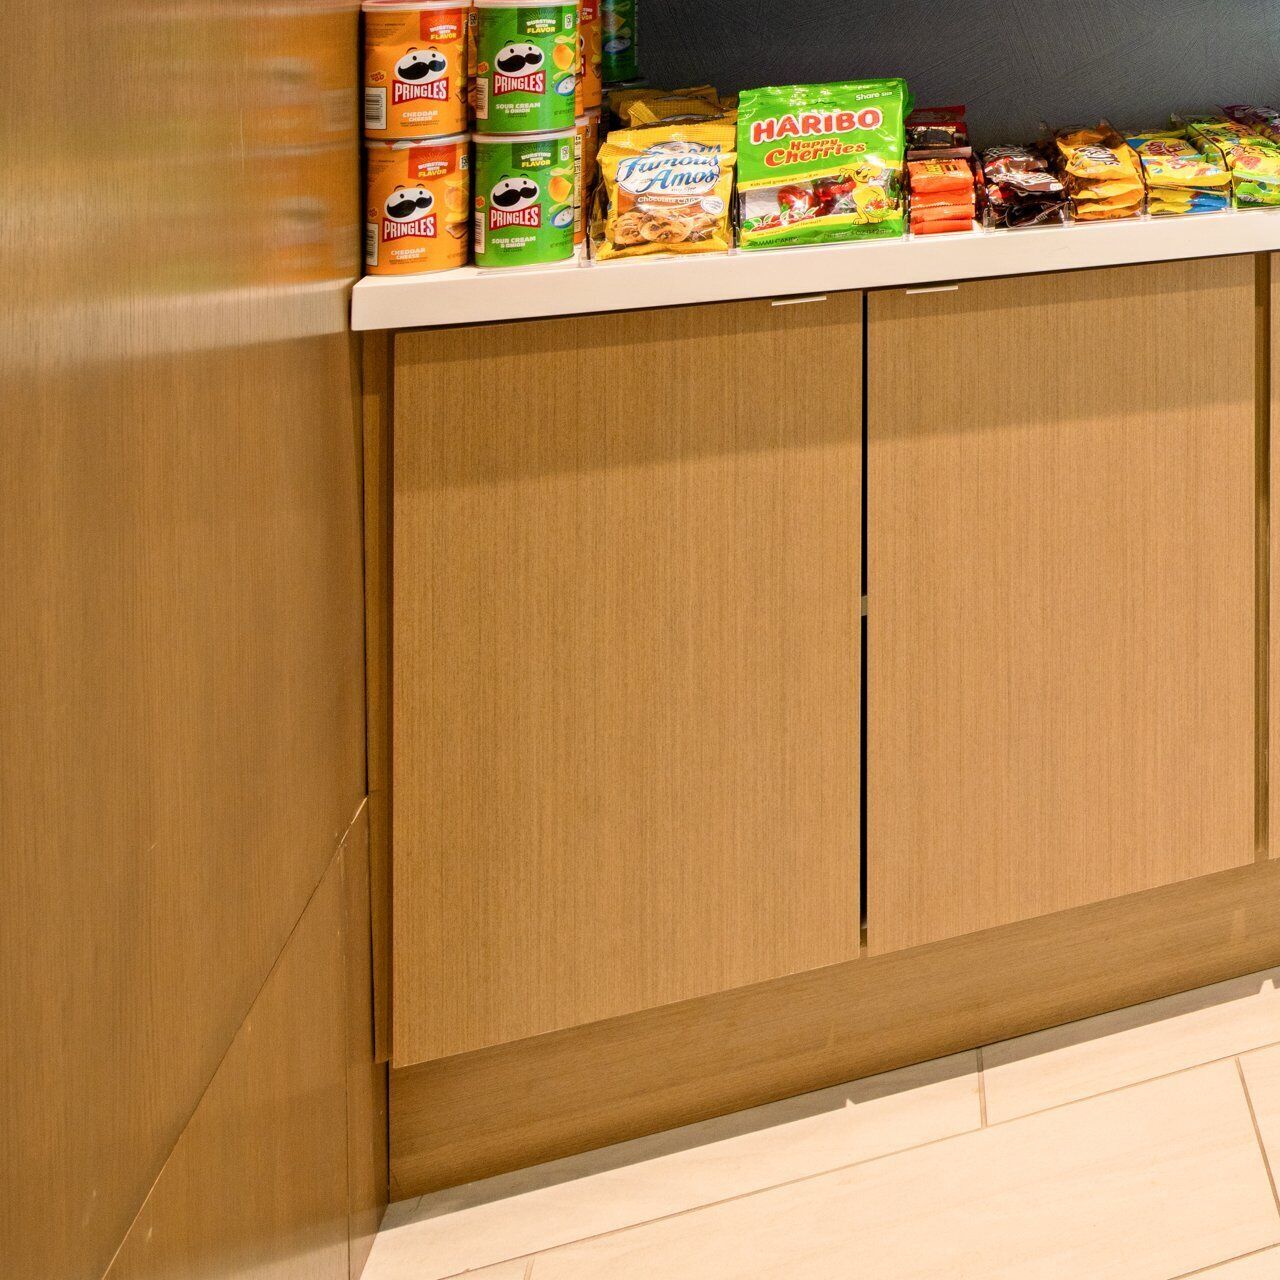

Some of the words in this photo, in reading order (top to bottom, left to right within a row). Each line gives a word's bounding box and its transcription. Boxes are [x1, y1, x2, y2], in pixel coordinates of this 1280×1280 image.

[526, 26, 556, 34] FLAVOR
[430, 32, 457, 40] FLAVOR
[494, 73, 545, 94] PRINGLES
[394, 80, 447, 101] PRINGLES
[495, 103, 513, 111] SOUR
[514, 102, 541, 110] CREAM
[402, 110, 438, 118] CHEDDAR
[752, 108, 882, 145] HARIBO
[790, 139, 840, 152] Happy
[764, 143, 866, 167] Cherries
[521, 159, 551, 168] FLAVOR
[615, 155, 719, 183] Famous
[418, 169, 447, 177] FLAVOR
[639, 169, 720, 193] Amos
[637, 195, 676, 204] Chocolate
[677, 197, 698, 205] Chip
[490, 207, 540, 227] PRINGLES
[384, 217, 435, 239] PRINGLES
[510, 235, 536, 244] CREAM
[390, 248, 426, 256] CHEDDAR
